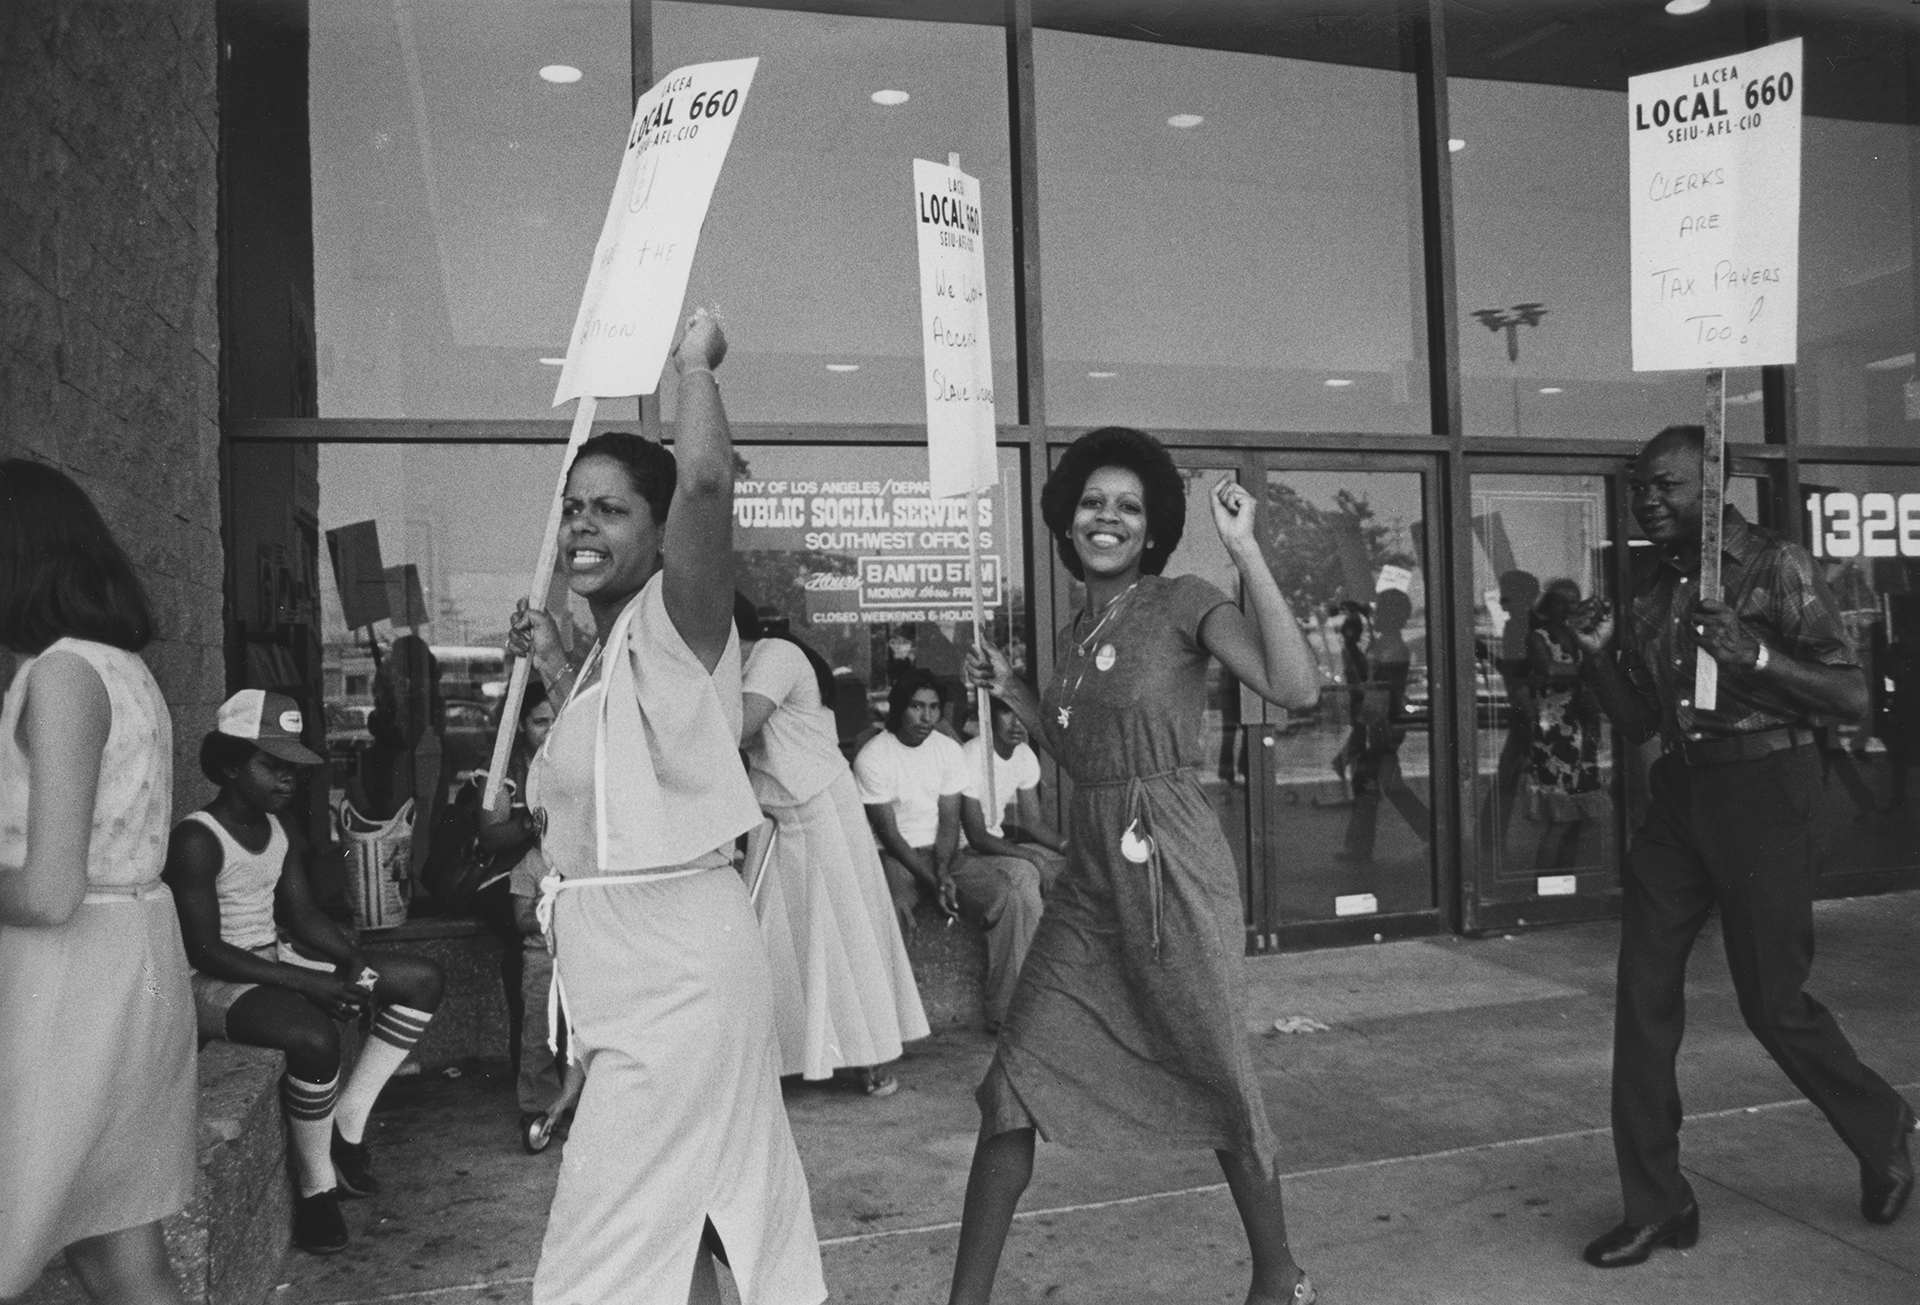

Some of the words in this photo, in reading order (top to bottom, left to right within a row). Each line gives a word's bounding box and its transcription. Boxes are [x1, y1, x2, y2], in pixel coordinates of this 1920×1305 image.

[1693, 65, 1739, 88] LACEA
[1636, 88, 1729, 131] LOCAL
[1745, 71, 1794, 110] 660
[628, 97, 675, 150] LOCAL
[689, 88, 739, 120] 660
[1668, 112, 1762, 144] SEIU-AFL-CIO
[920, 191, 965, 230] LOCAL
[1680, 214, 1720, 238] ARE
[767, 481, 788, 495] OF
[790, 481, 819, 495] LOS
[810, 497, 891, 528] SOCIAL
[893, 497, 993, 528] SERVICS
[804, 531, 916, 550] SOUTHWEST
[919, 531, 994, 549] OFFICS
[866, 587, 918, 600] MONDAY
[812, 611, 859, 623] CLOSED
[860, 610, 926, 623] WEEKENDS
[927, 609, 939, 622] &
